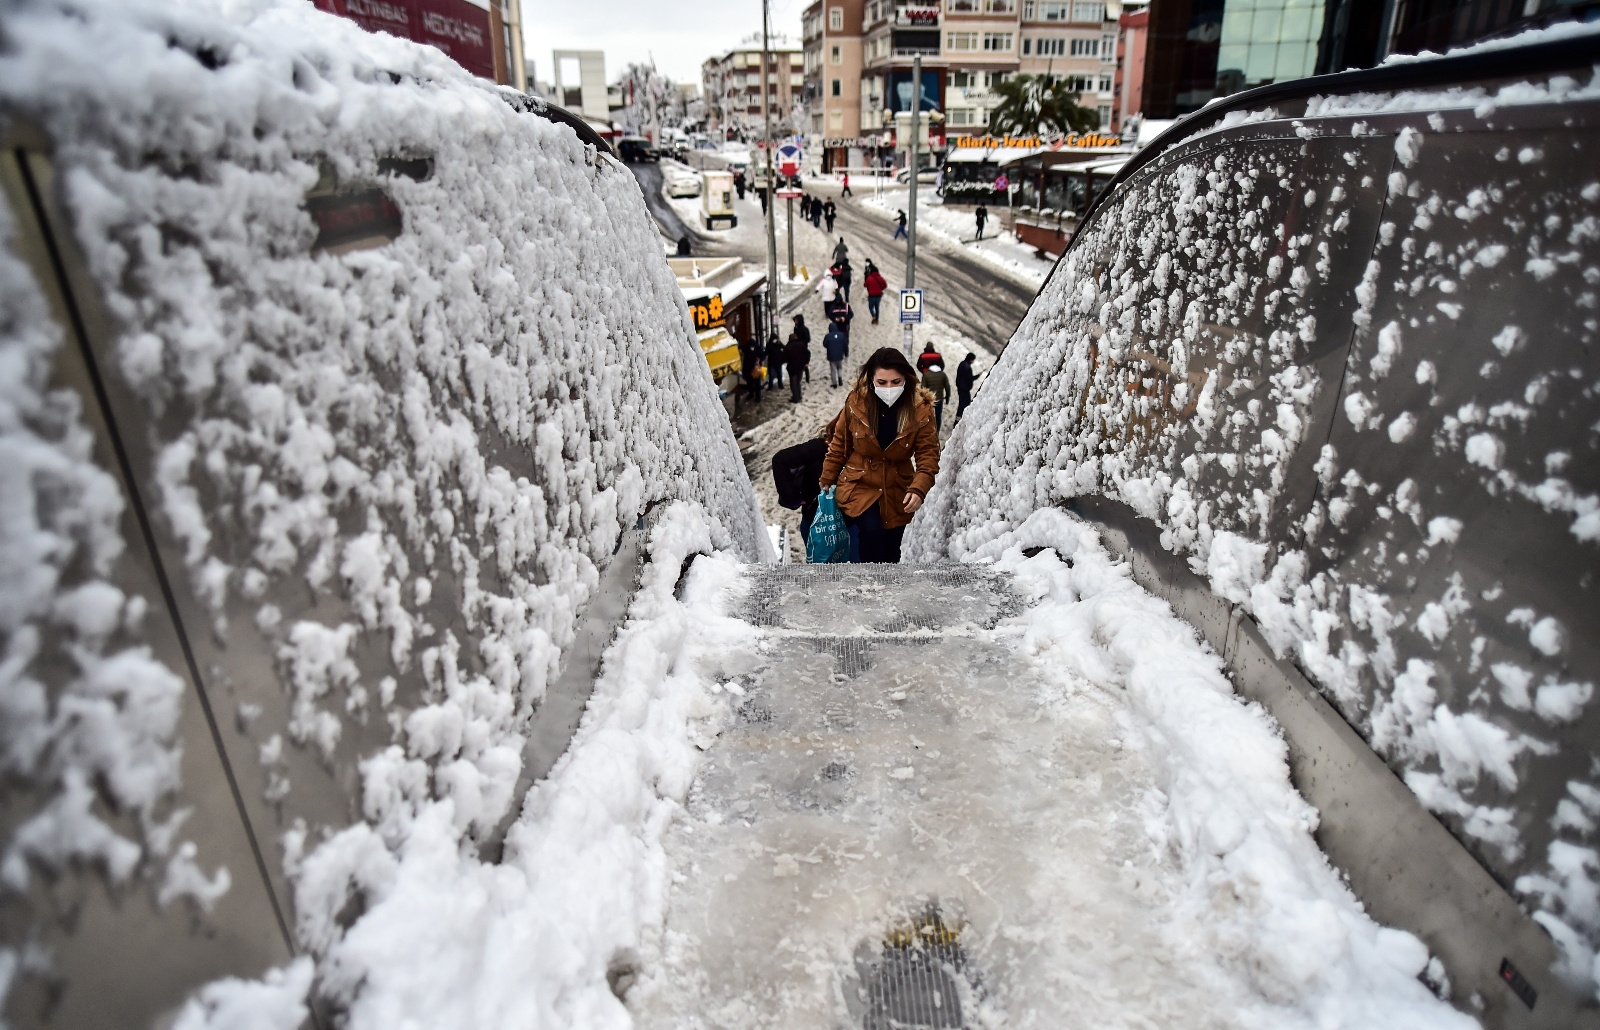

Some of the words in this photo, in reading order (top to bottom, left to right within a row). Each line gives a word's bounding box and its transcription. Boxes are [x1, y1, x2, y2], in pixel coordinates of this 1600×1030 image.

[957, 135, 999, 149] Gloria
[1003, 133, 1042, 149] Jean's
[1067, 133, 1121, 149] Coffees
[905, 296, 916, 309] D
[711, 365, 734, 378] STA
